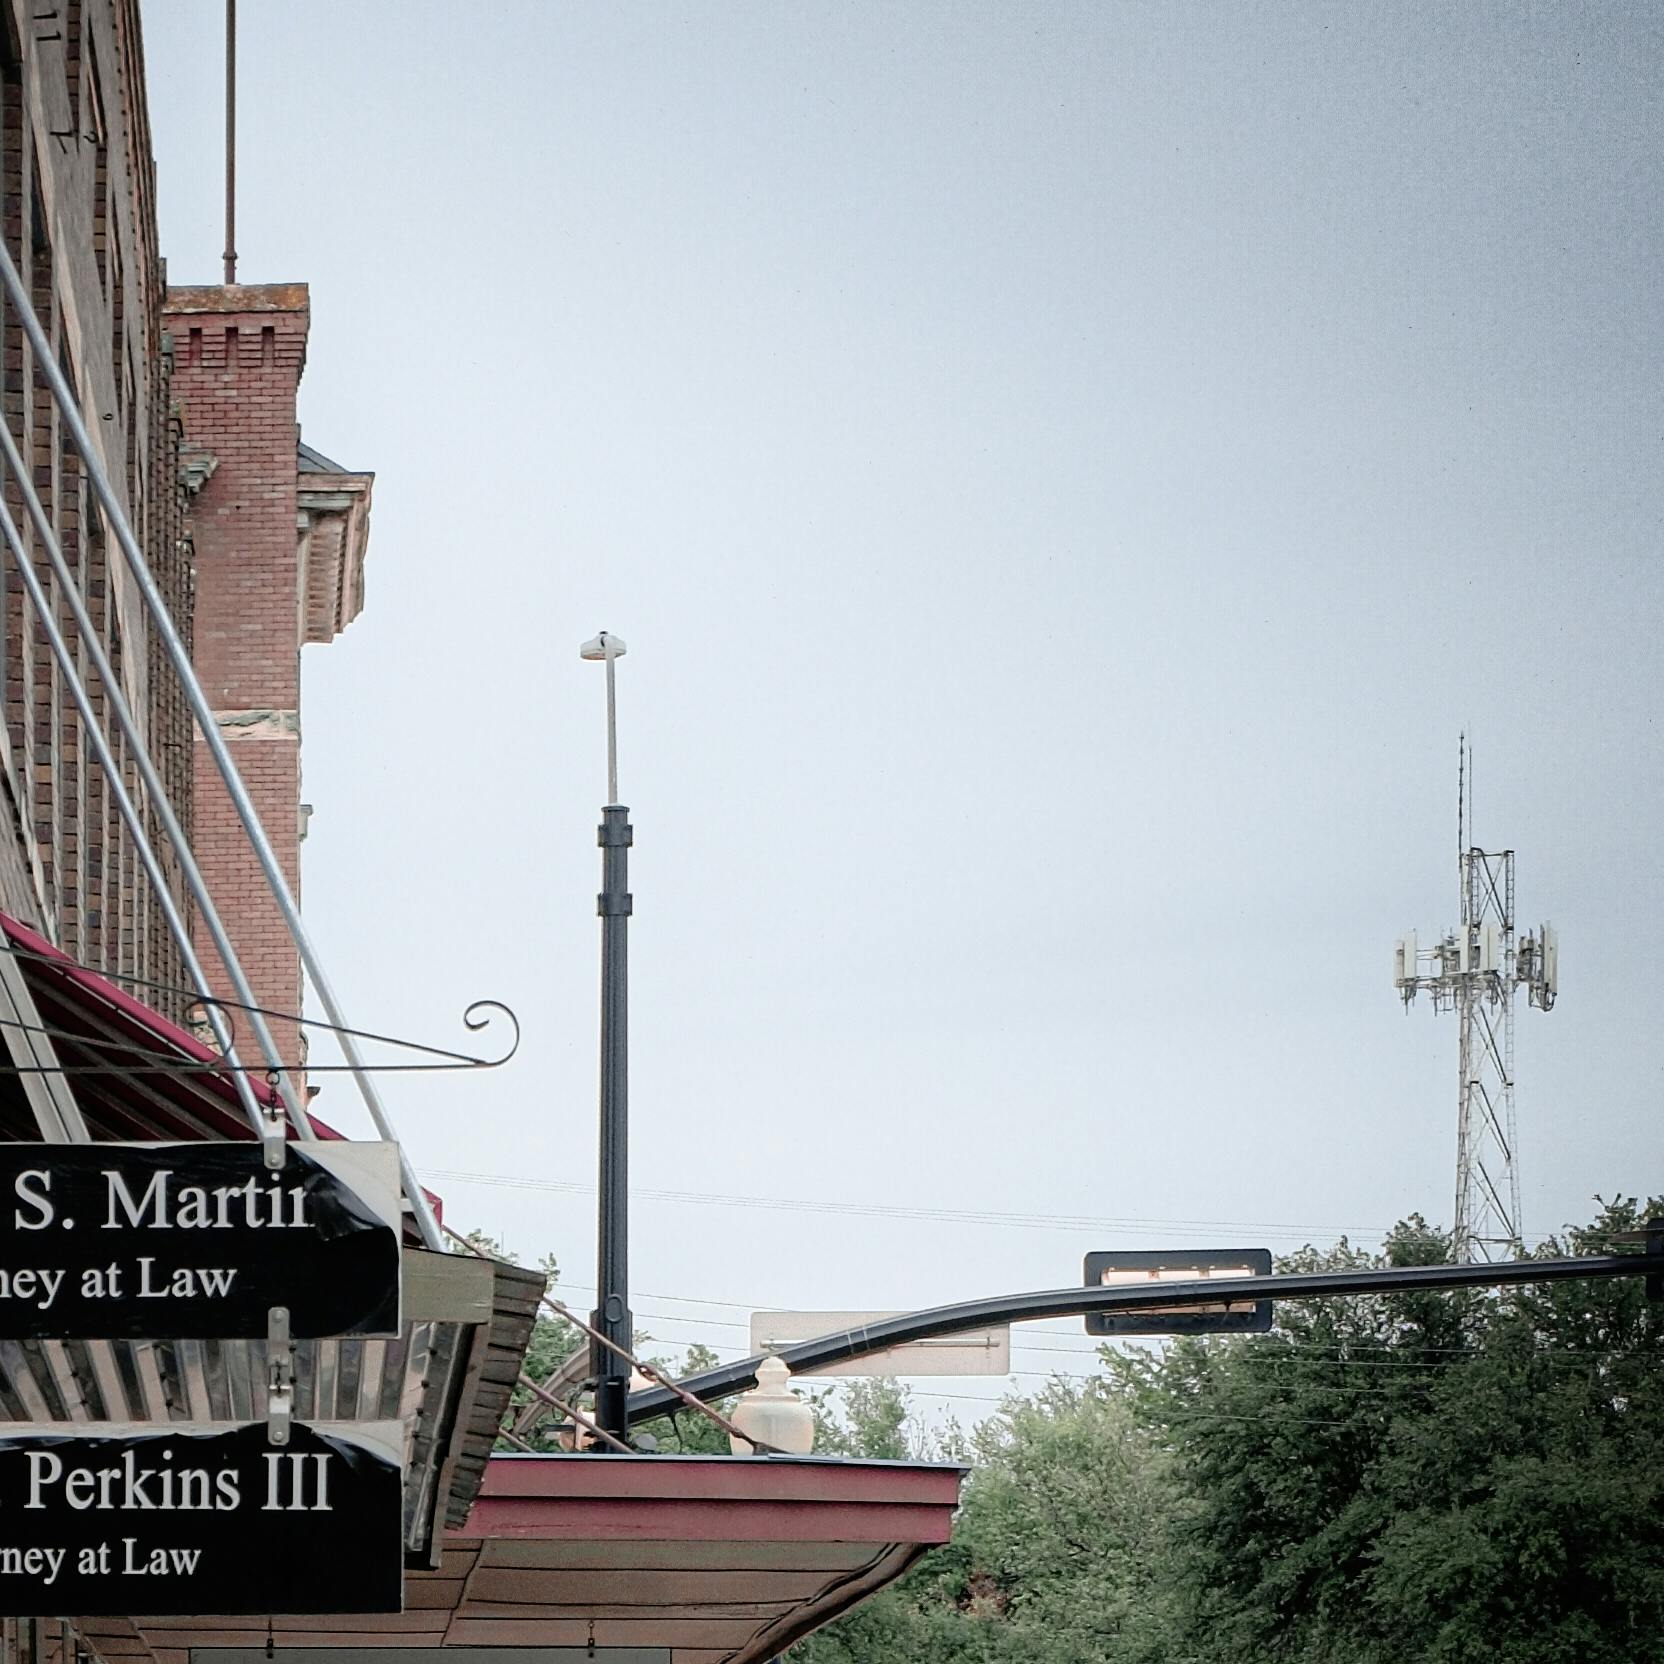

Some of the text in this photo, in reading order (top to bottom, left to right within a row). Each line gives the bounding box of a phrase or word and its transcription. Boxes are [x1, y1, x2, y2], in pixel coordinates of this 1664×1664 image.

[15, 1170, 74, 1230] S.
[82, 1262, 122, 1298] at
[136, 1258, 238, 1298] Law
[24, 1451, 240, 1511] Perkins
[262, 1453, 333, 1511] III
[78, 1542, 114, 1575] at
[122, 1538, 202, 1575] Law
